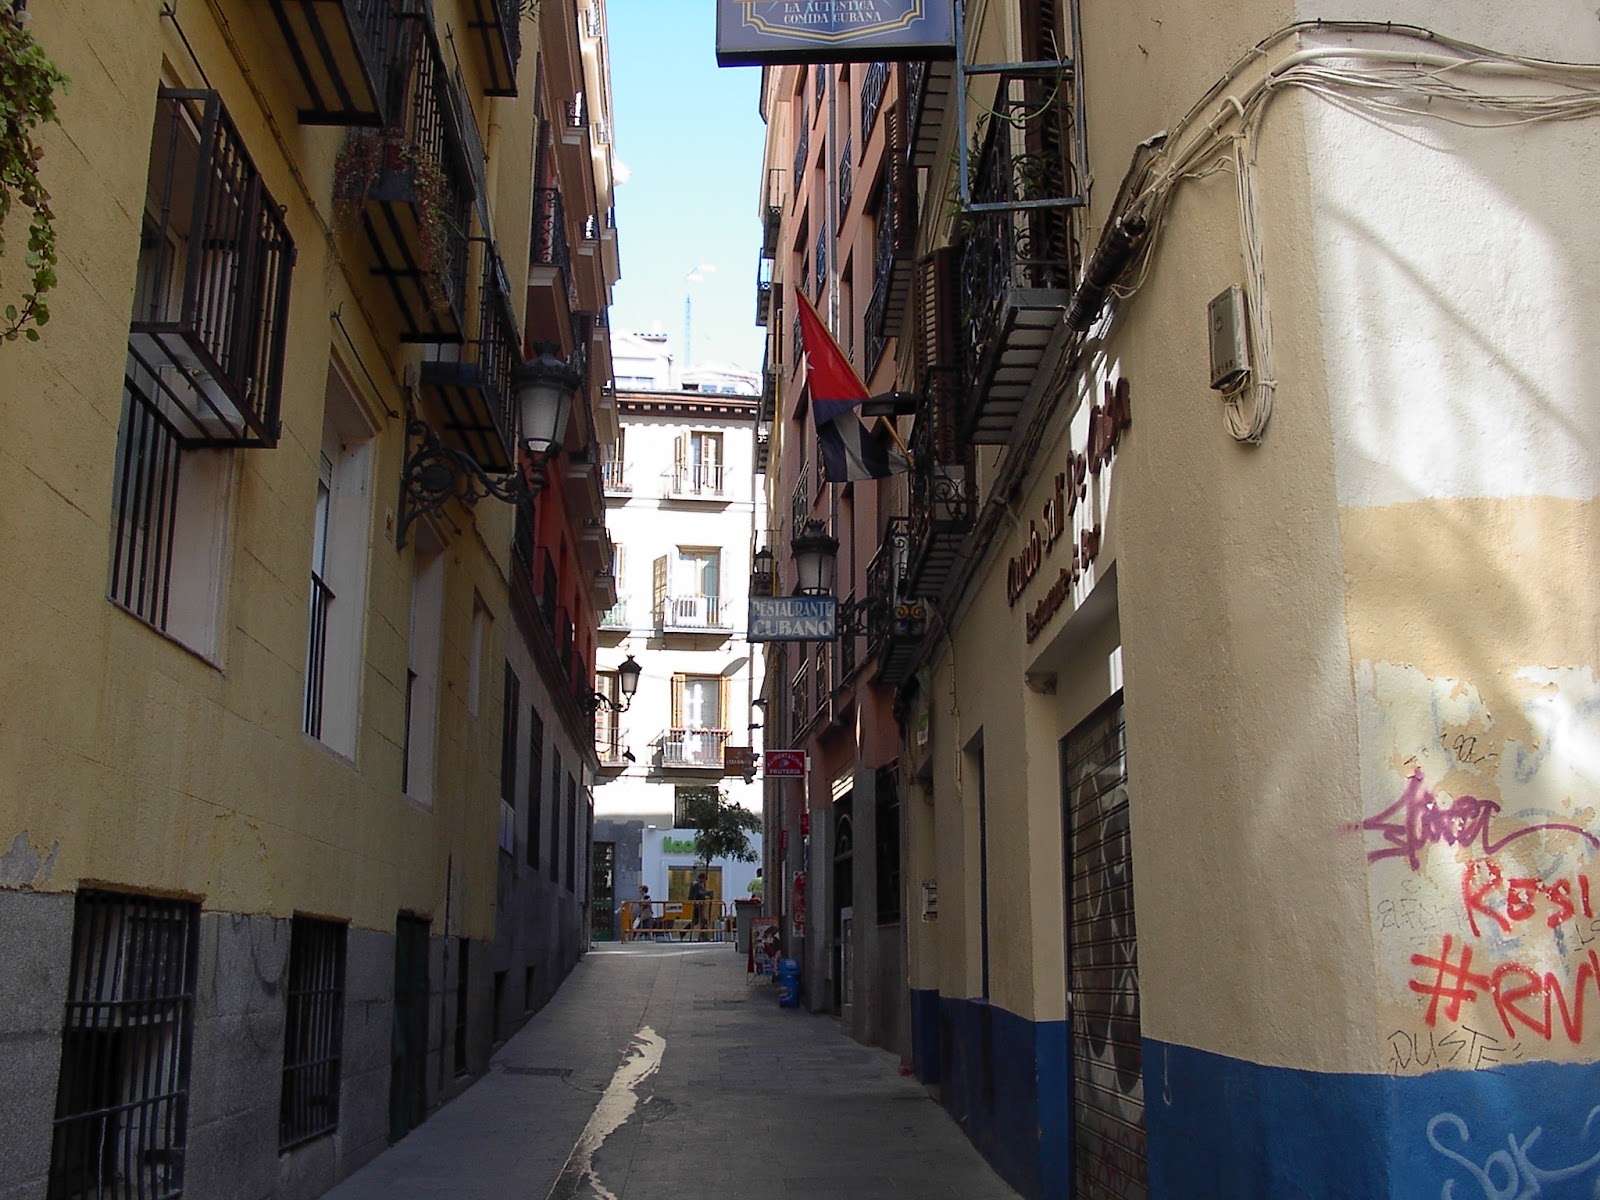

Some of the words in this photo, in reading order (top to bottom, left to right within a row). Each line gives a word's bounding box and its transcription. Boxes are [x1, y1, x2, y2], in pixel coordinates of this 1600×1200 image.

[784, 2, 800, 13] LA
[784, 13, 829, 25] COMIDA
[752, 600, 833, 618] RESTAURANTE
[752, 619, 833, 637] CUBANO
